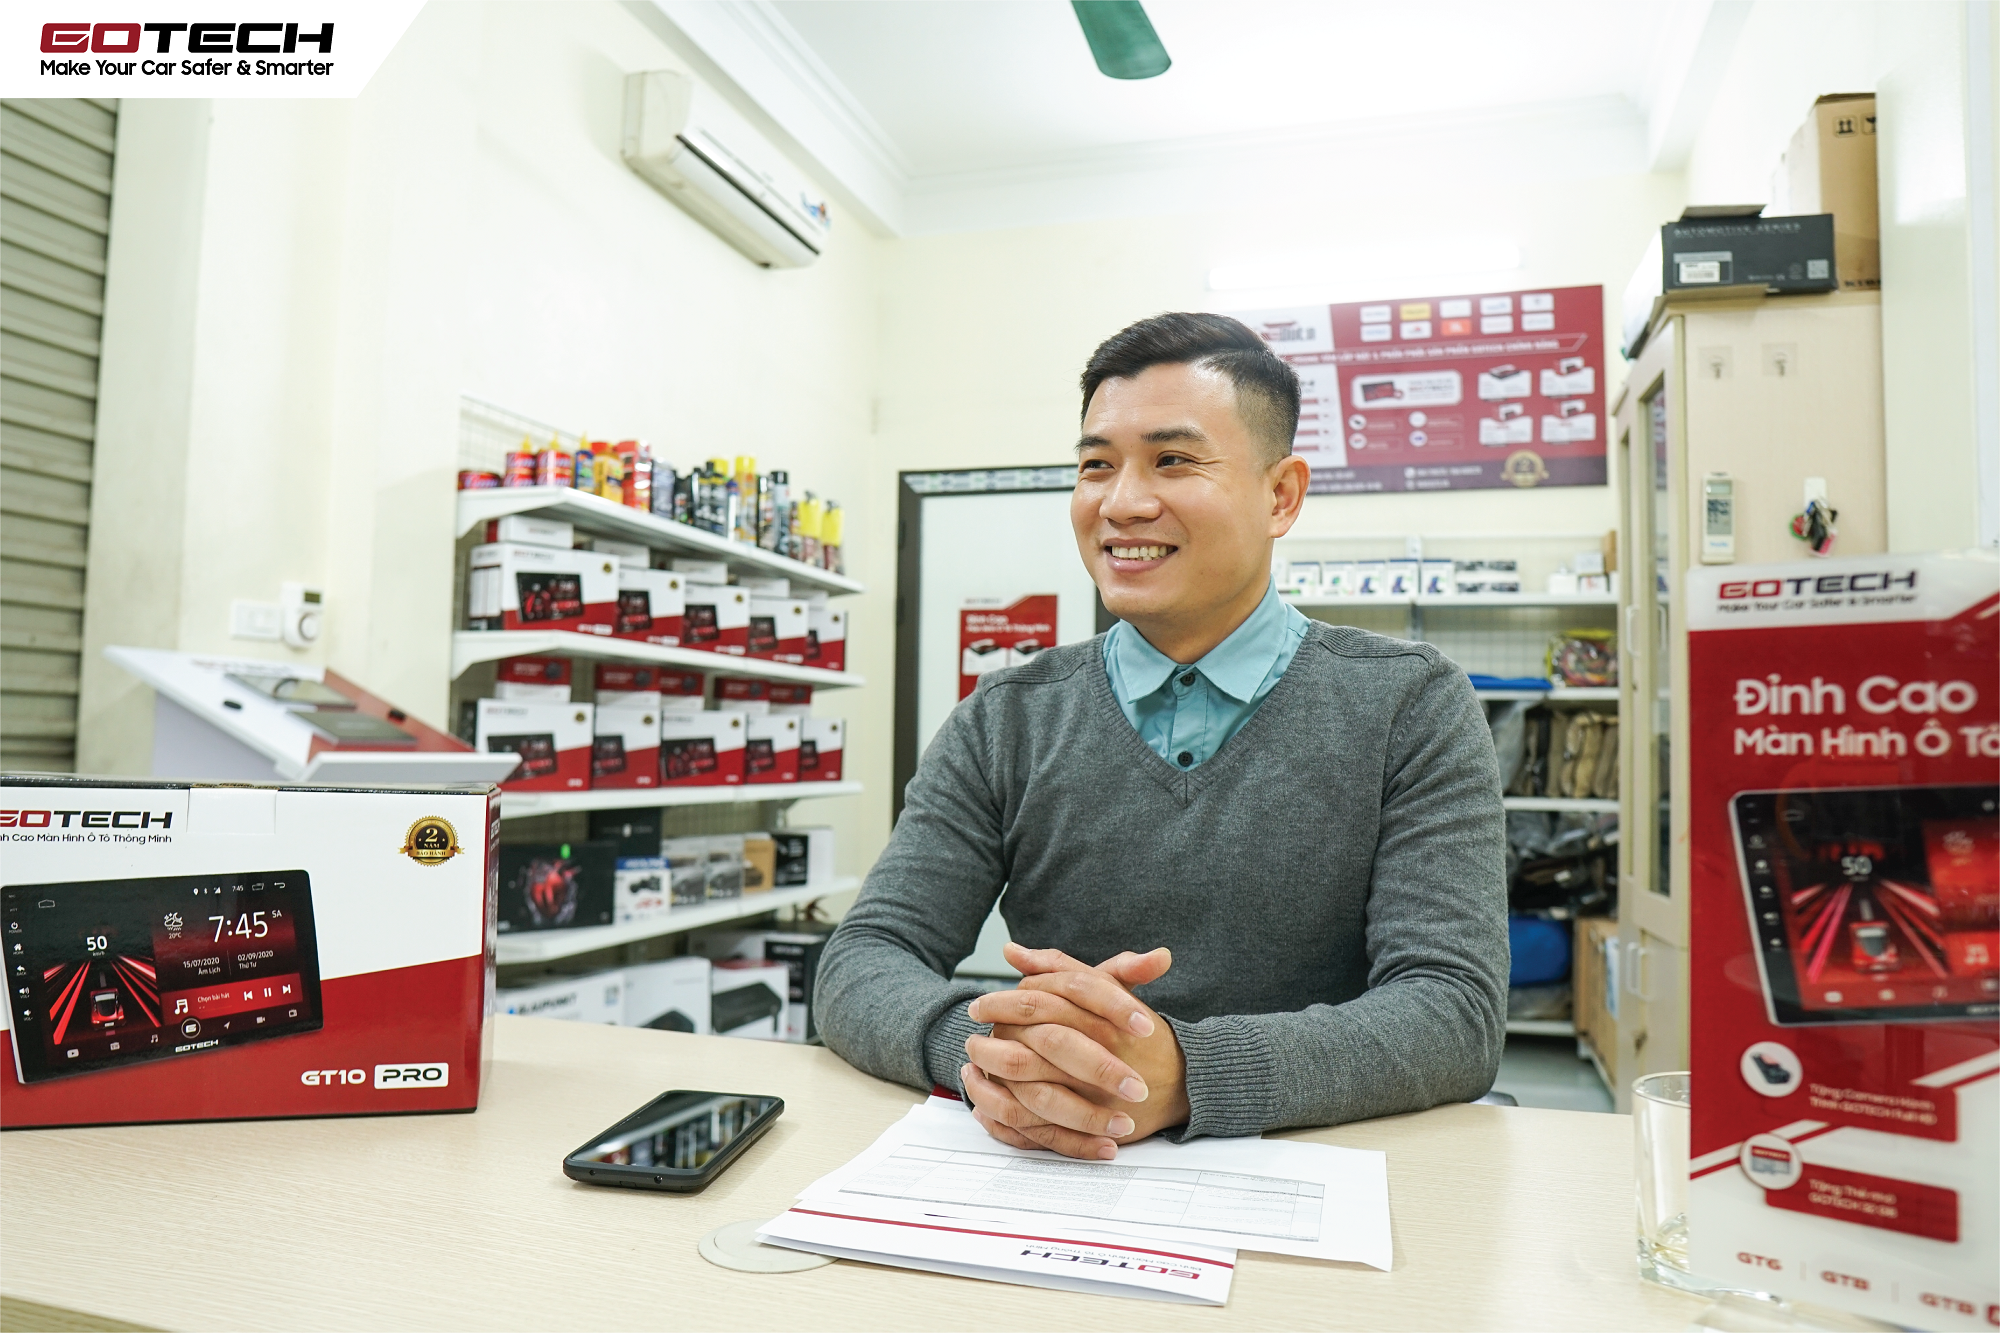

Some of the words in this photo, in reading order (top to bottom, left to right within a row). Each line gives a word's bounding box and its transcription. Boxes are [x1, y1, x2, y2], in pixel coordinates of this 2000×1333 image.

[1718, 569, 1917, 599] GOTECH
[1733, 673, 1846, 715] Đỉnh
[1857, 675, 1978, 714] Cao
[1733, 724, 1814, 756] Màn
[1821, 724, 1908, 757] Hình
[1914, 717, 1951, 757] Ô
[12, 833, 35, 842] Cao
[37, 832, 60, 843] Màn
[62, 833, 85, 843] Hình
[87, 831, 96, 843] Ô
[98, 833, 111, 843] Tô
[113, 833, 146, 846] Thông
[148, 833, 173, 843] Minh
[425, 827, 438, 843] 2
[1841, 856, 1873, 876] 50
[208, 911, 269, 943] 7:45
[272, 909, 283, 919] SA
[86, 936, 108, 951] 50
[183, 956, 220, 969] 15/07/2020
[237, 950, 274, 962] 02/09/2020
[174, 1039, 219, 1053] GOTECH
[301, 1068, 366, 1086] GT10
[382, 1067, 442, 1082] PRO
[1020, 1249, 1200, 1279] GOTECH
